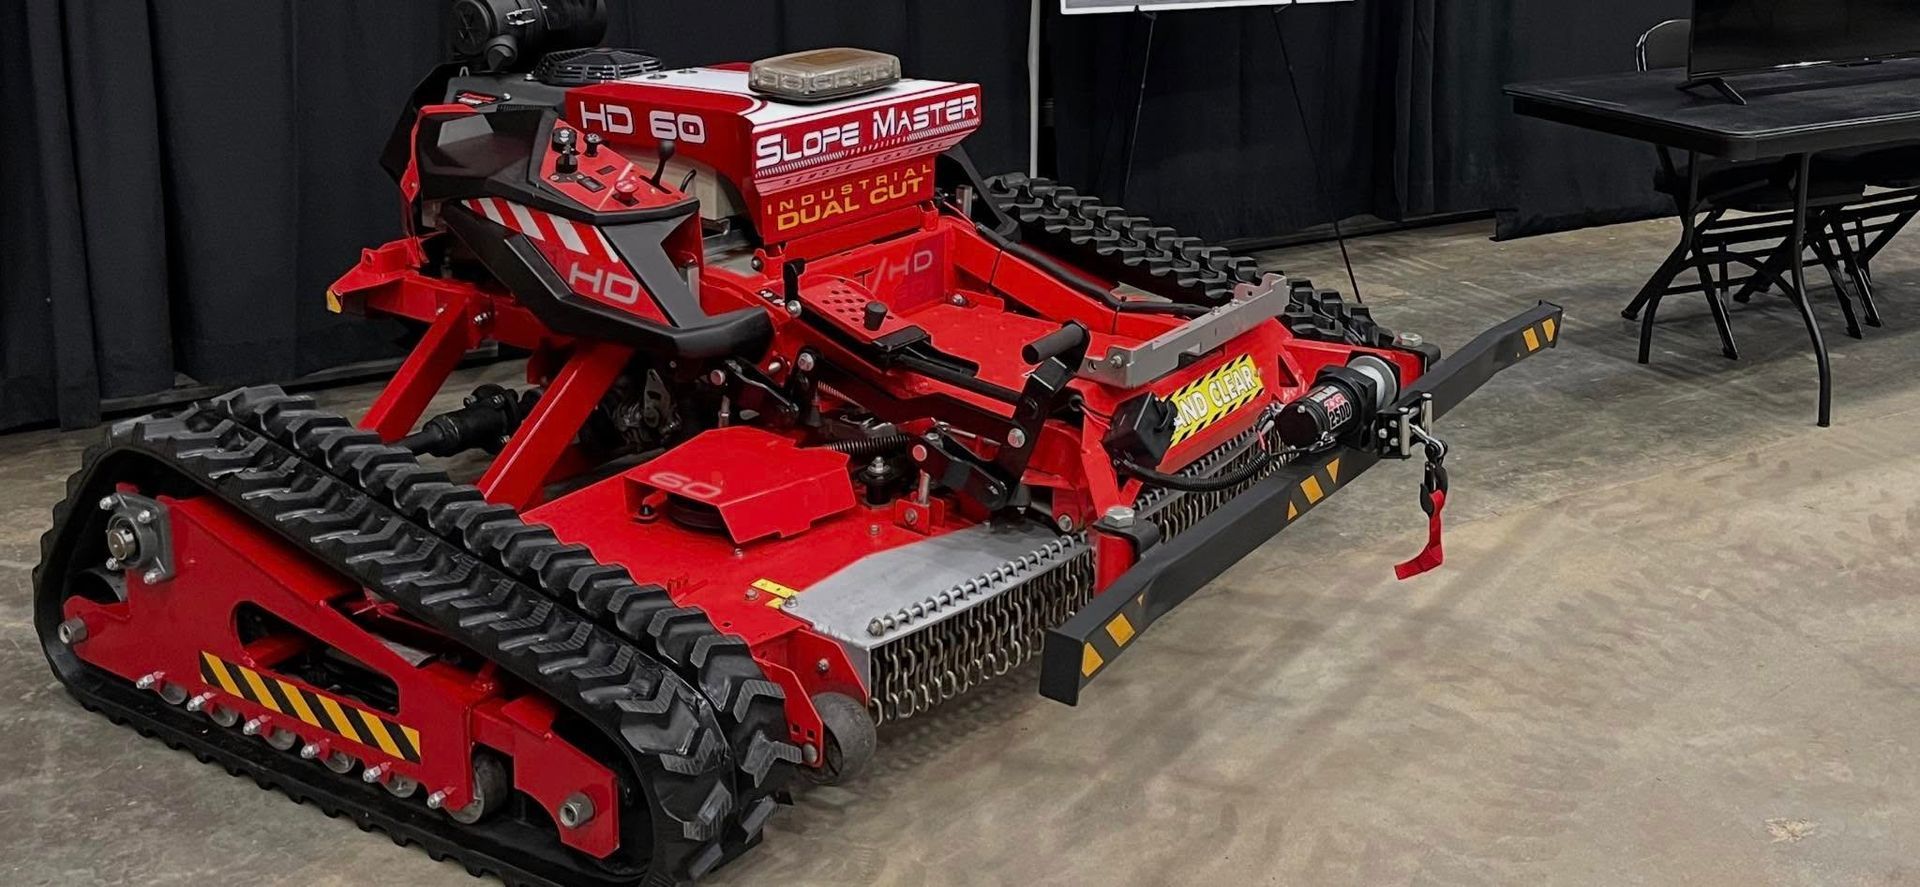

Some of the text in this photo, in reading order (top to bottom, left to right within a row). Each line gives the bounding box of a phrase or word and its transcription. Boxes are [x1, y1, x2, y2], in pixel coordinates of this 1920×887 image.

[580, 101, 706, 144] HD 60
[755, 121, 860, 169] SLOPE
[873, 95, 977, 140] MASTER
[767, 164, 931, 215] INDUSTRIAL
[777, 176, 924, 231] DUAL CUT
[568, 262, 640, 305] HD
[1207, 365, 1257, 408] CLEAR
[1328, 401, 1352, 430] 2500
[649, 471, 723, 500] 60
